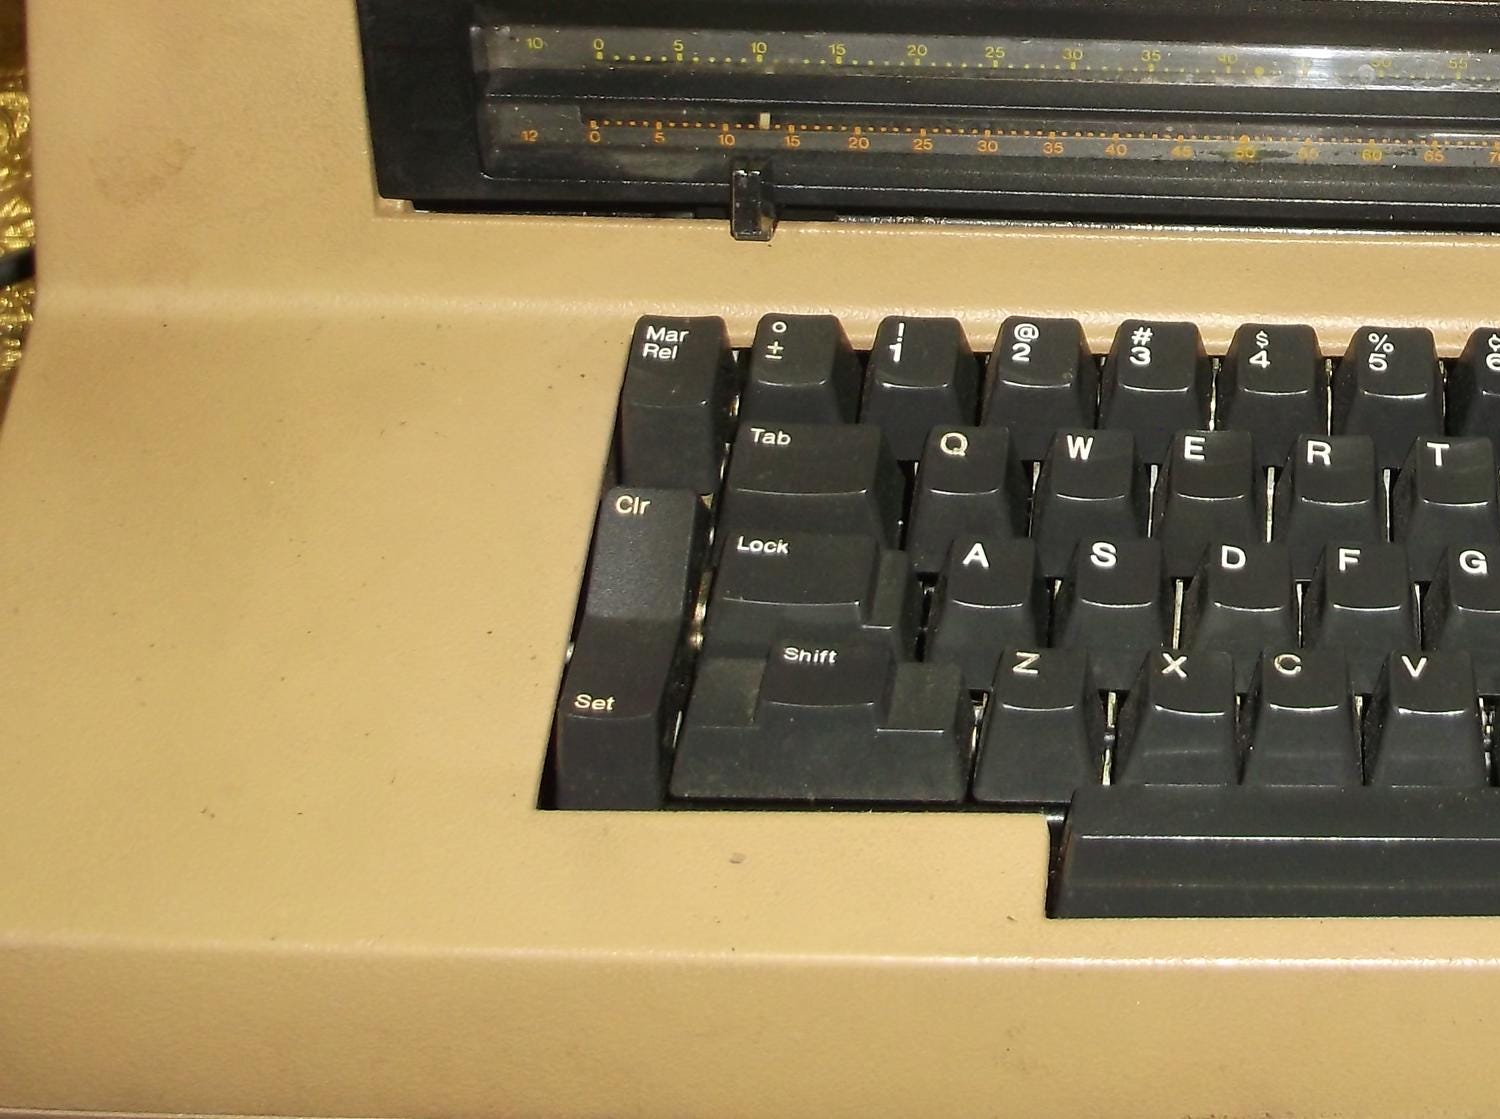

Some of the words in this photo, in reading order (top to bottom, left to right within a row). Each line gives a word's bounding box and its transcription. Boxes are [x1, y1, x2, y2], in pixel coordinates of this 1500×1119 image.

[526, 37, 543, 49] 10
[592, 38, 604, 50] 0
[672, 40, 683, 52] 5
[751, 41, 768, 54] 10
[830, 44, 845, 56] 15
[907, 44, 927, 56] 20
[985, 46, 1004, 58] 25
[1063, 48, 1081, 60] 30
[1140, 49, 1161, 61] 35
[587, 131, 600, 143] 0
[653, 132, 665, 144] 5
[719, 134, 735, 146] 10
[784, 135, 800, 147] 15
[848, 137, 869, 150] 20
[913, 138, 932, 151] 25
[977, 140, 997, 152] 30
[1044, 142, 1062, 154] 35
[1105, 144, 1127, 156] 40
[1361, 149, 1382, 161] 60
[1424, 150, 1444, 162] 65
[646, 326, 689, 342] Mar
[897, 323, 904, 342] !
[1014, 324, 1039, 342] @
[1132, 327, 1152, 345] #
[1256, 331, 1268, 348] $
[643, 343, 677, 359] Rel
[889, 343, 901, 362] 1
[1012, 343, 1030, 362] 2
[1369, 333, 1394, 353] %
[1130, 347, 1150, 365] 3
[1250, 351, 1270, 368] 4
[1369, 353, 1387, 371] 5
[751, 428, 790, 445] Tab
[940, 433, 967, 456] Q
[1067, 435, 1093, 460] W
[1184, 436, 1205, 460] E
[1307, 441, 1331, 465] R
[1427, 442, 1449, 466] T
[615, 496, 650, 514] Clr
[737, 536, 788, 554] Lock
[963, 543, 989, 568] A
[1091, 543, 1116, 568] S
[1222, 546, 1245, 569] D
[1339, 549, 1360, 571] F
[1460, 551, 1487, 574] G
[784, 648, 836, 663] Shift
[1013, 652, 1039, 674] Z
[1162, 653, 1187, 678] X
[1274, 654, 1301, 675] C
[1402, 656, 1426, 678] V
[574, 694, 614, 710] Set
